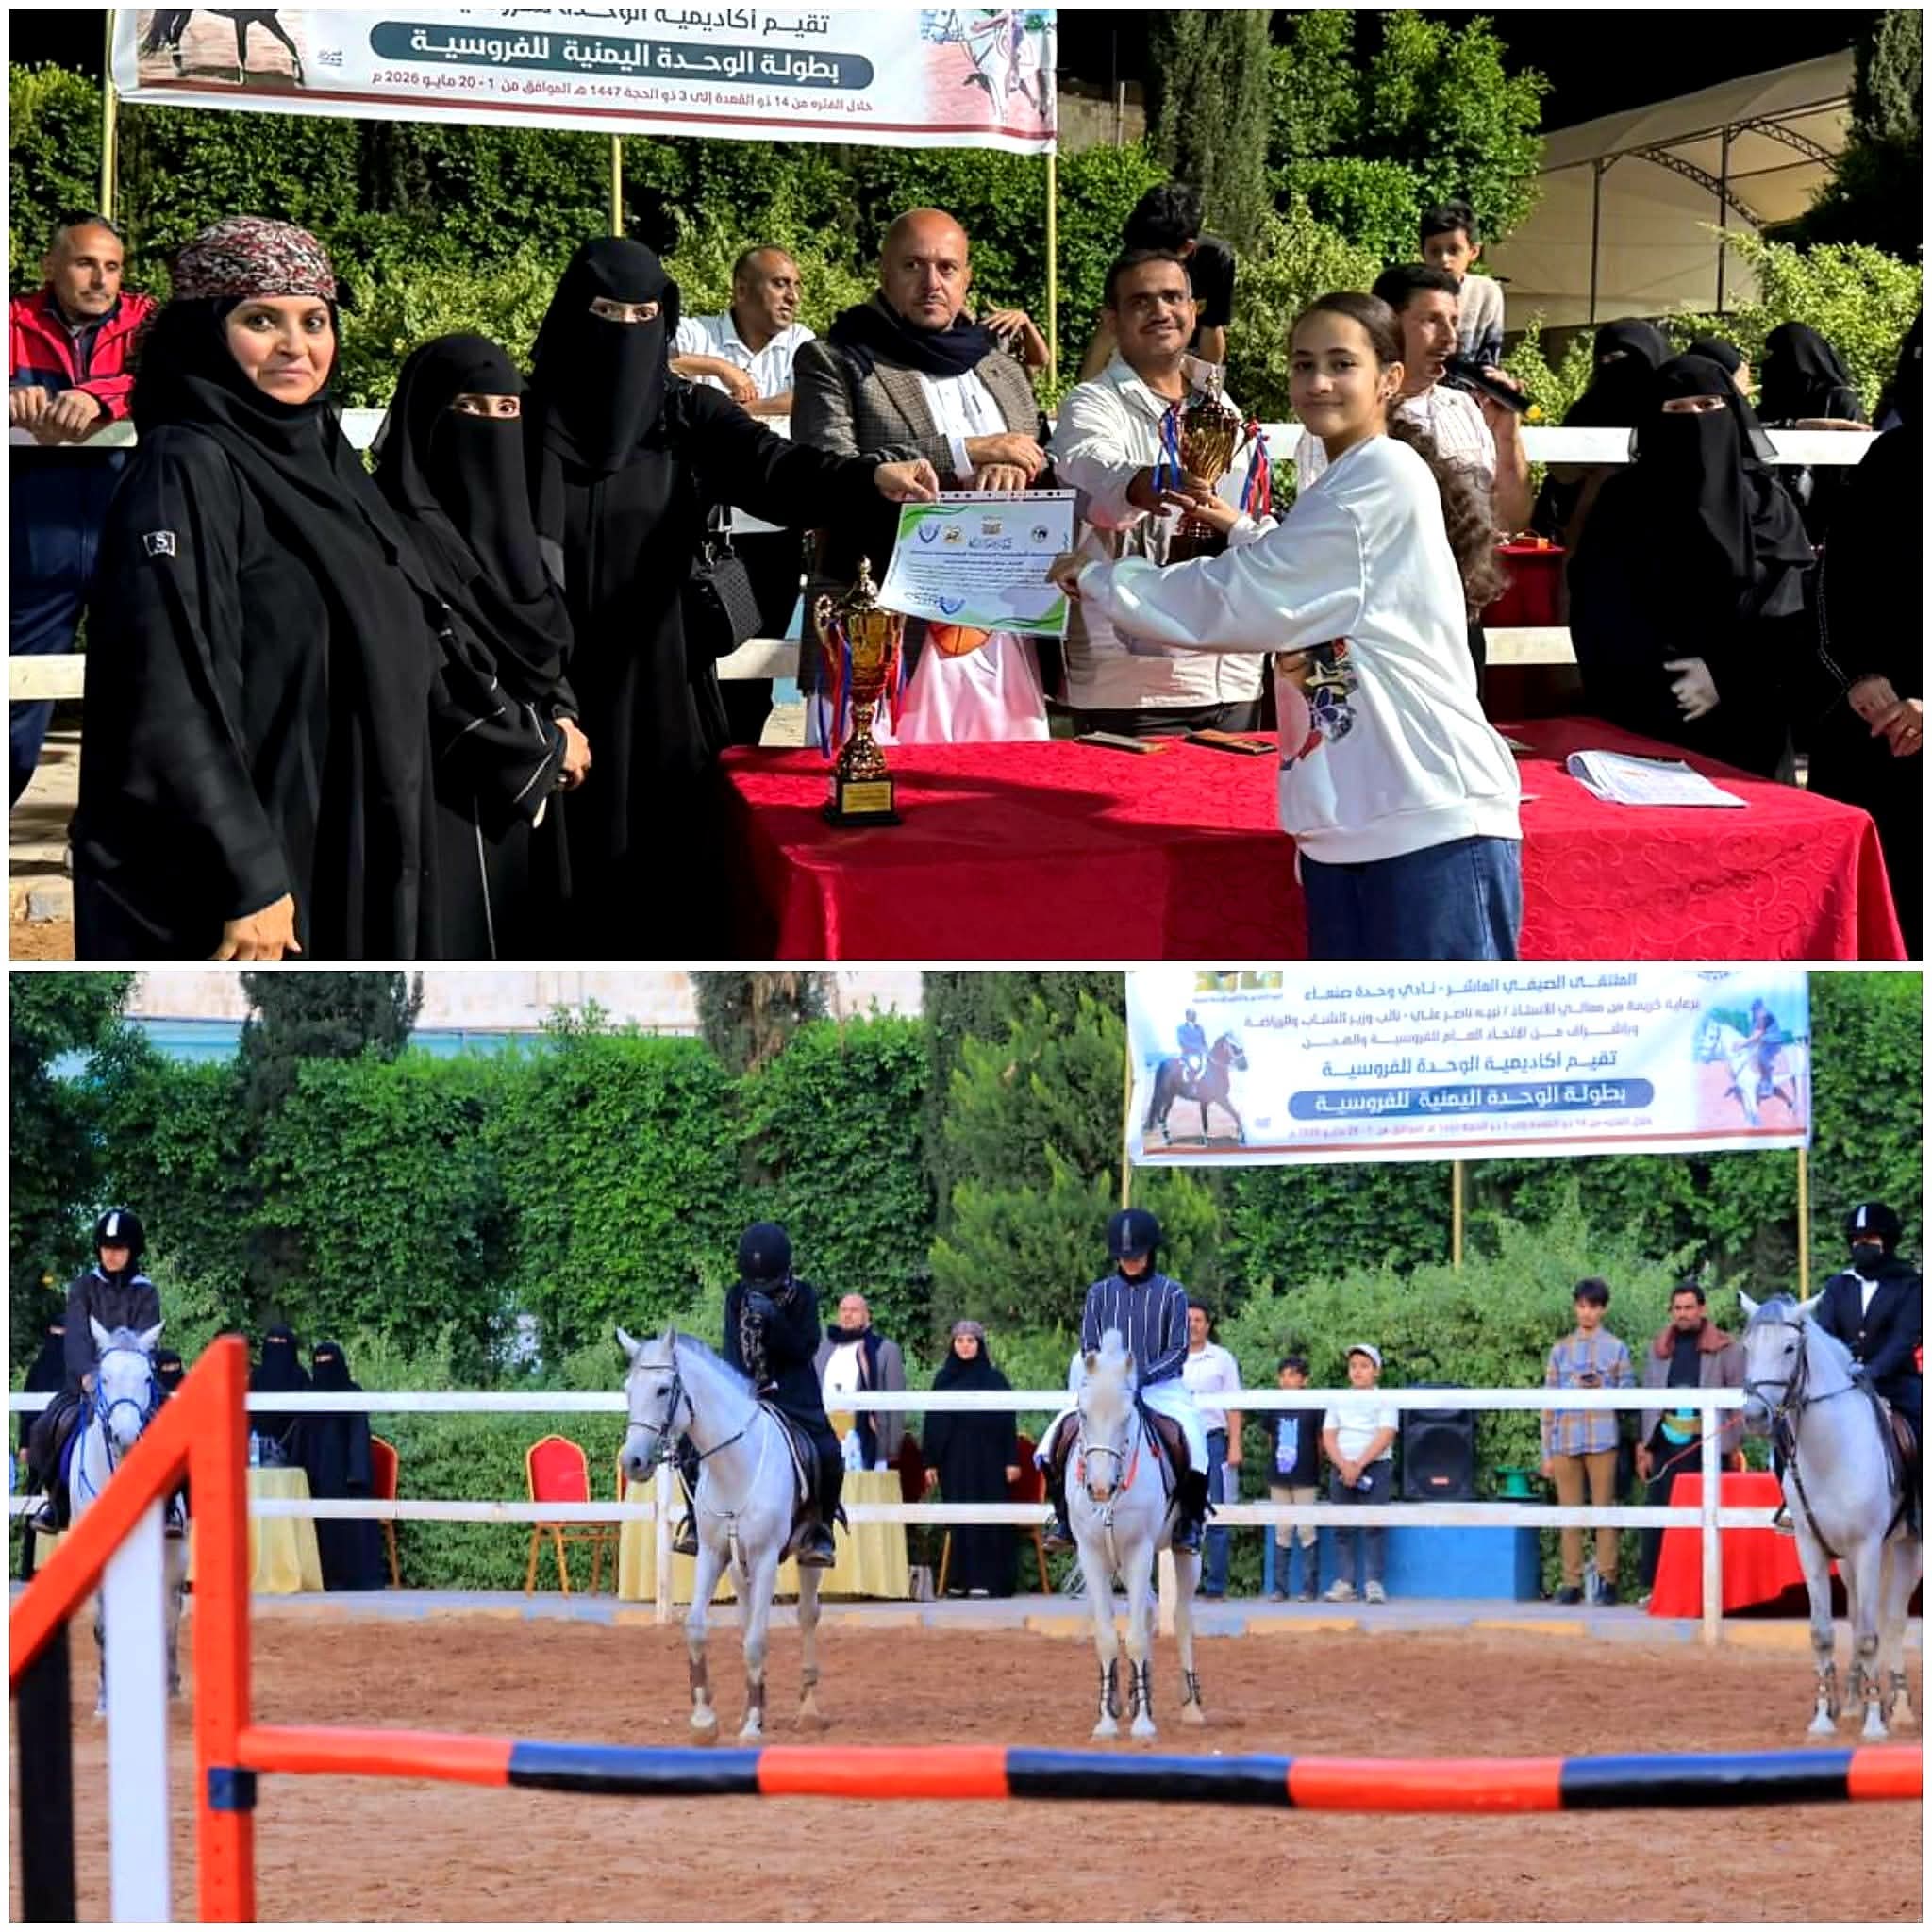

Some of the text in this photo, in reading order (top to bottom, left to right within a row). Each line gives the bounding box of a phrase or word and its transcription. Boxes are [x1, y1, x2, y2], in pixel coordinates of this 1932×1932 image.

[763, 14, 830, 38] تقيم
[409, 29, 840, 85] بطولة الوحدة اليمنية للفروسية
[372, 72, 382, 84] م
[384, 71, 421, 84] 2026
[422, 73, 457, 89] مايو
[458, 75, 476, 88] 20
[488, 77, 494, 89] 1
[501, 80, 519, 93] من
[522, 80, 572, 95] الموافق
[590, 85, 623, 97] 1447
[624, 87, 659, 100] الحجة
[660, 90, 676, 103] ذو
[678, 90, 688, 101] 3
[715, 92, 755, 106] القعدة
[757, 95, 772, 108] ذو
[774, 95, 789, 107] 14
[791, 99, 808, 110] من
[846, 101, 873, 112] خلال
[1416, 1054, 1480, 1075] الوحدة
[1565, 1050, 1618, 1072] تقيم
[1322, 1057, 1412, 1080] للفروسية
[1314, 1083, 1626, 1115] بطولة الوحدة اليمنية للفروسية
